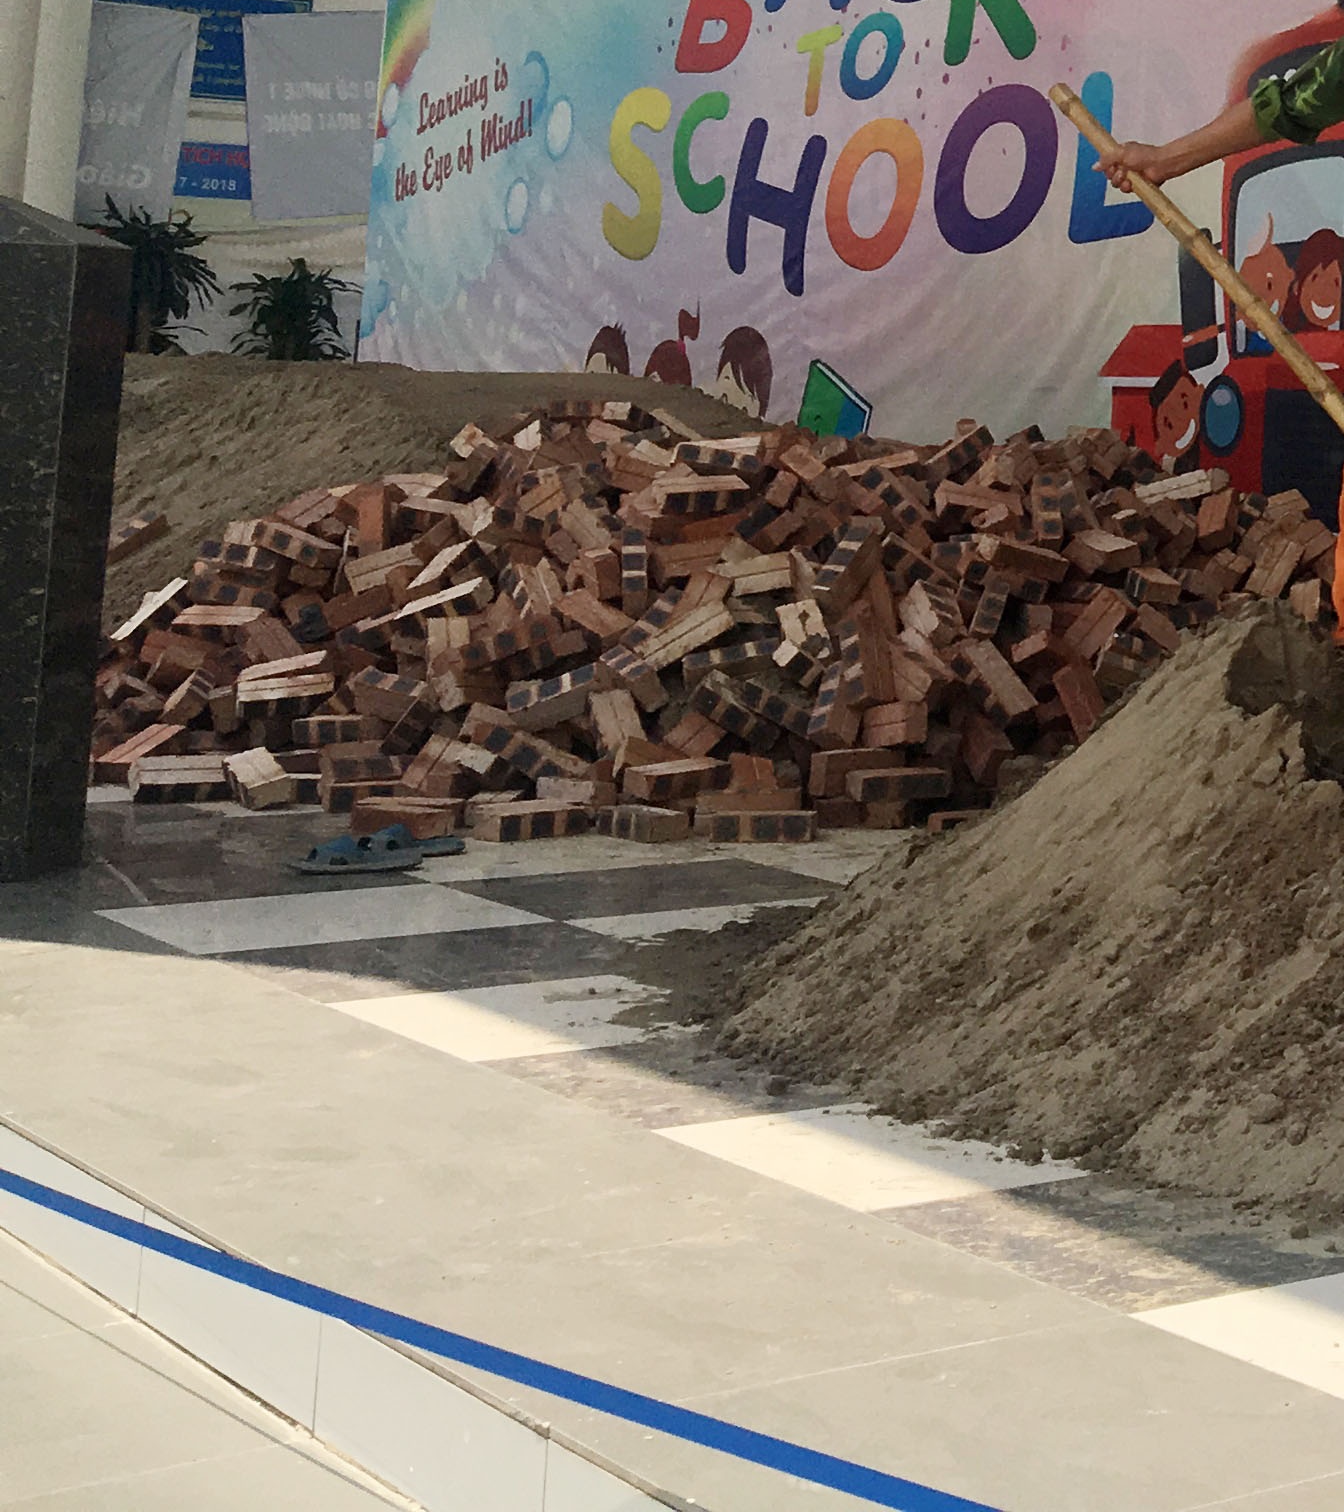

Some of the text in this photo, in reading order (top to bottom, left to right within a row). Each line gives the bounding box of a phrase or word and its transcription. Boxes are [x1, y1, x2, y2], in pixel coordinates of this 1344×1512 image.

[417, 74, 489, 136] Learning
[494, 58, 509, 93] is
[797, 12, 904, 117] TO
[395, 98, 533, 202] the Eye of Mind!
[602, 71, 1155, 297] SCHOOL
